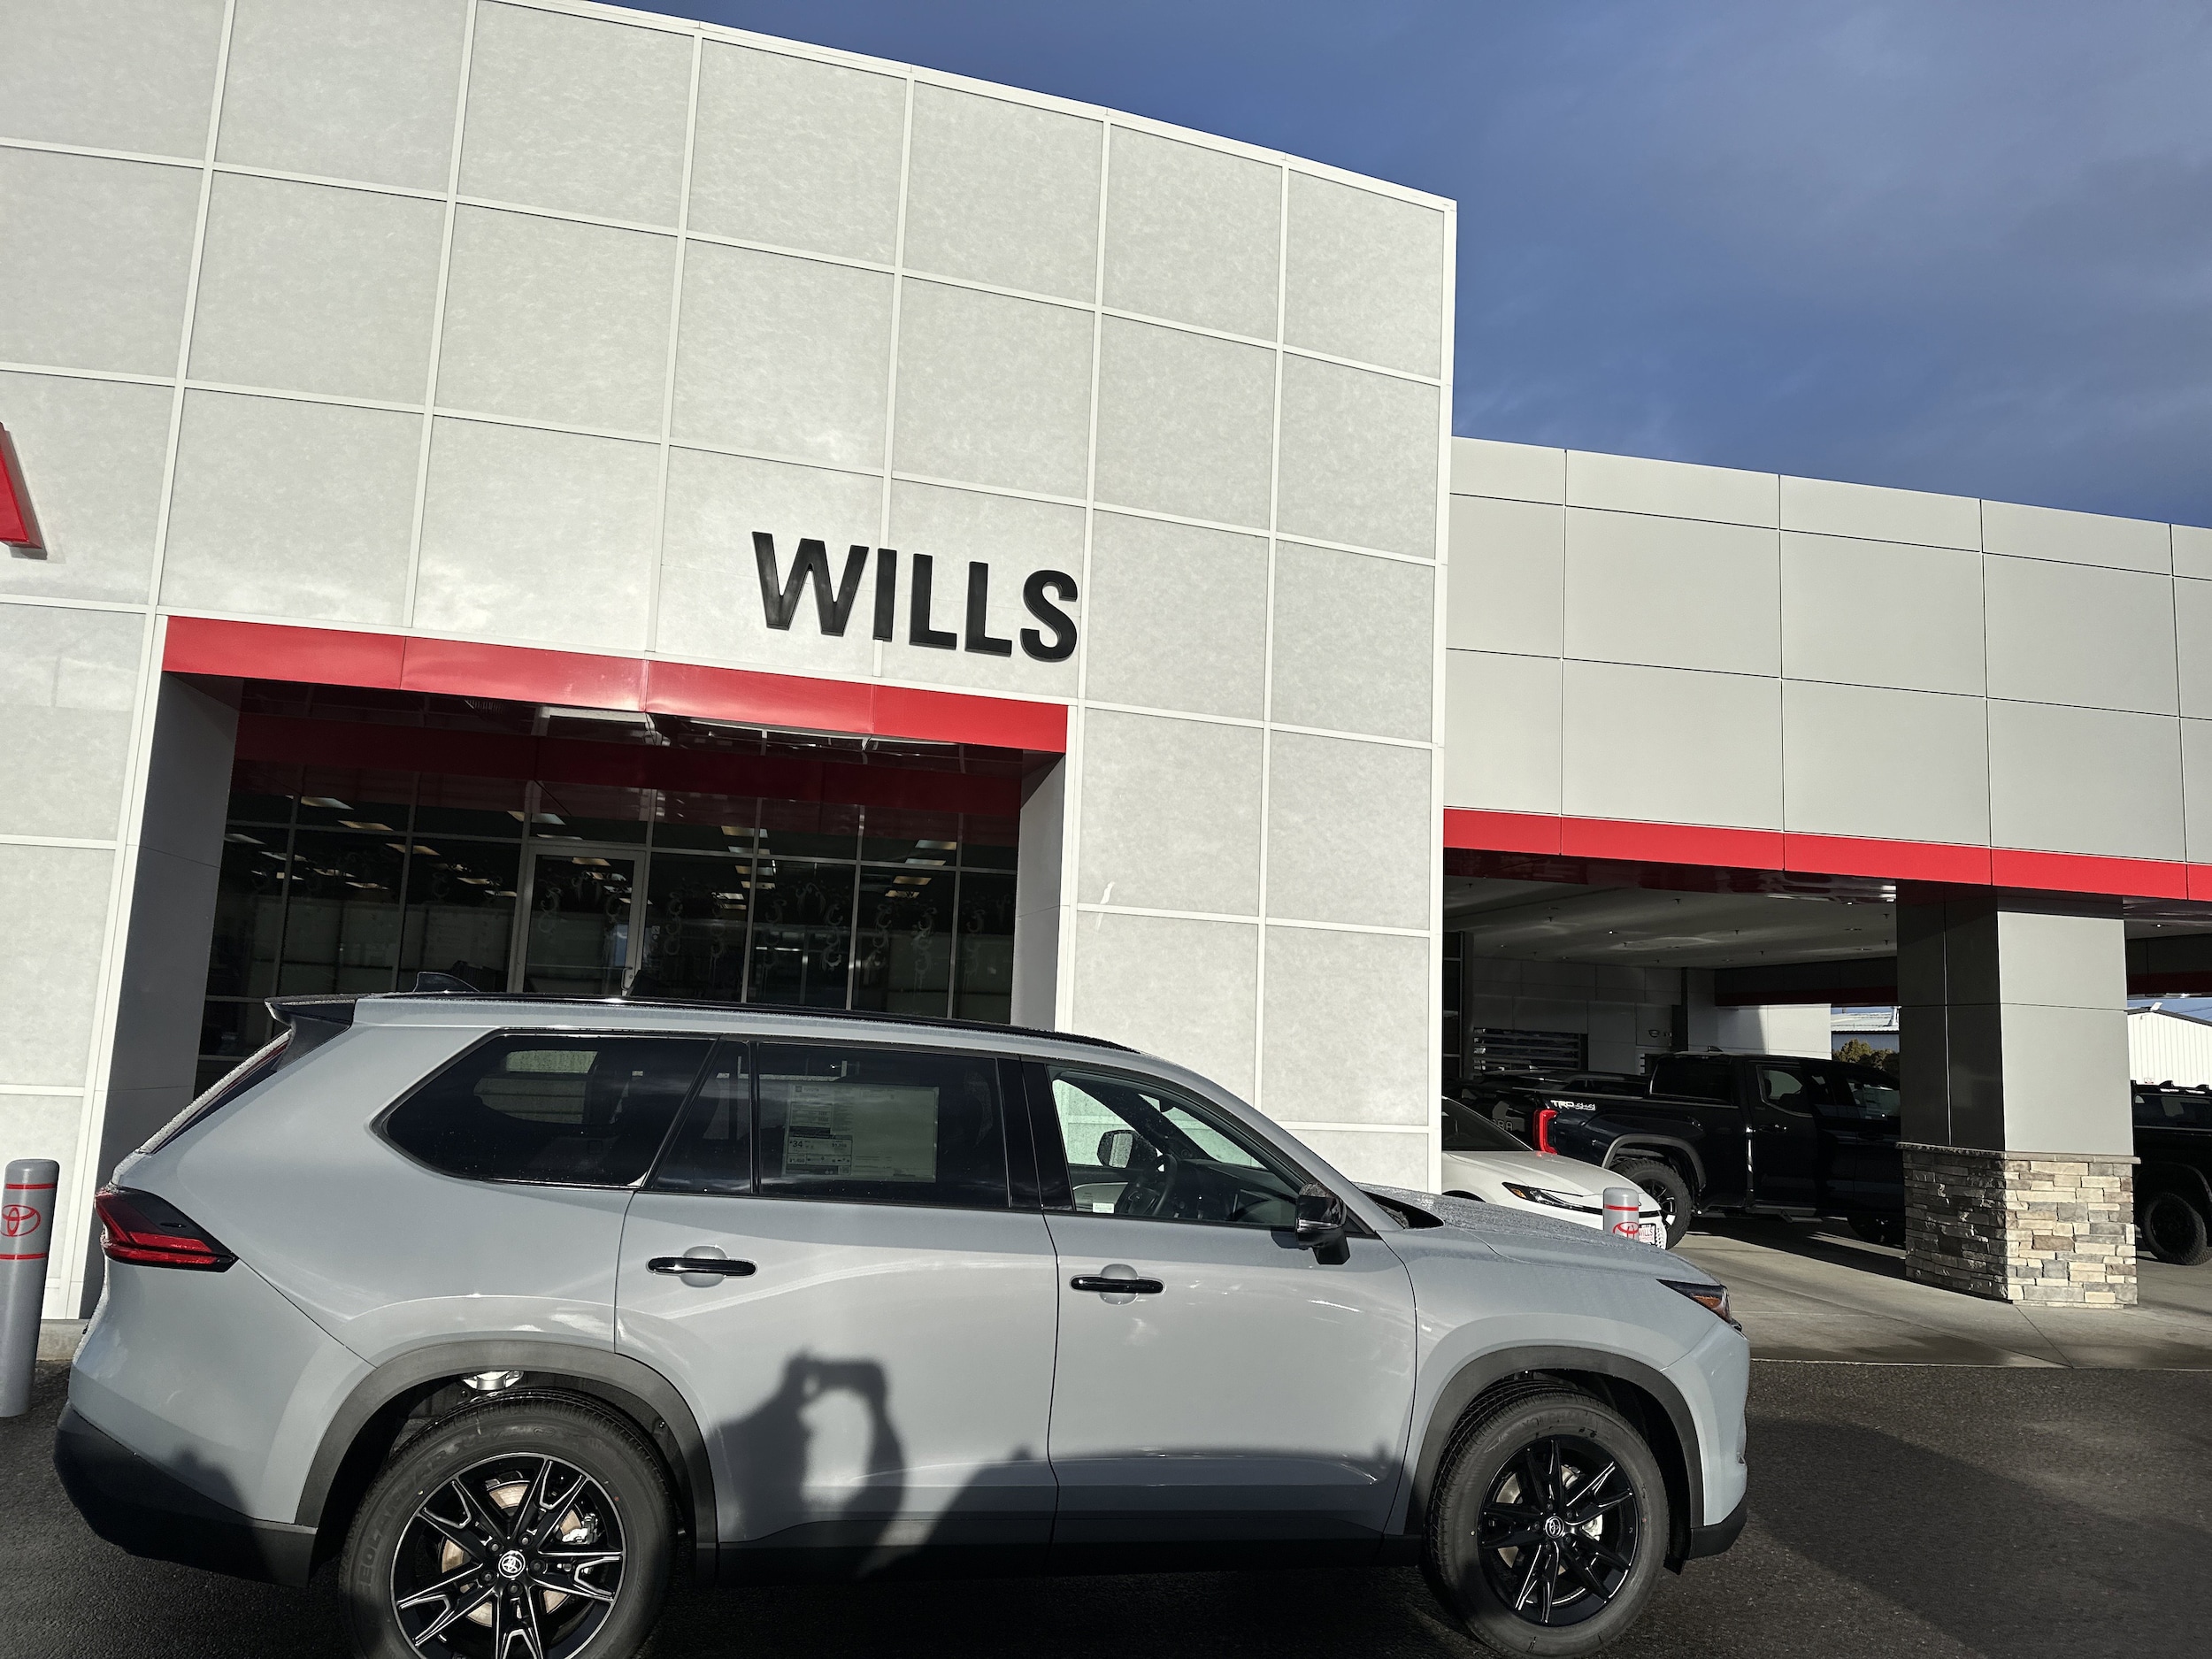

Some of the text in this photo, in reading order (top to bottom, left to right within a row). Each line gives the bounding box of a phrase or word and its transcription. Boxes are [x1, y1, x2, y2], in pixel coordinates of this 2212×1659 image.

[751, 531, 1079, 663] WILLS
[1549, 1099, 1575, 1110] TRD
[1638, 1228, 1654, 1237] WILLS
